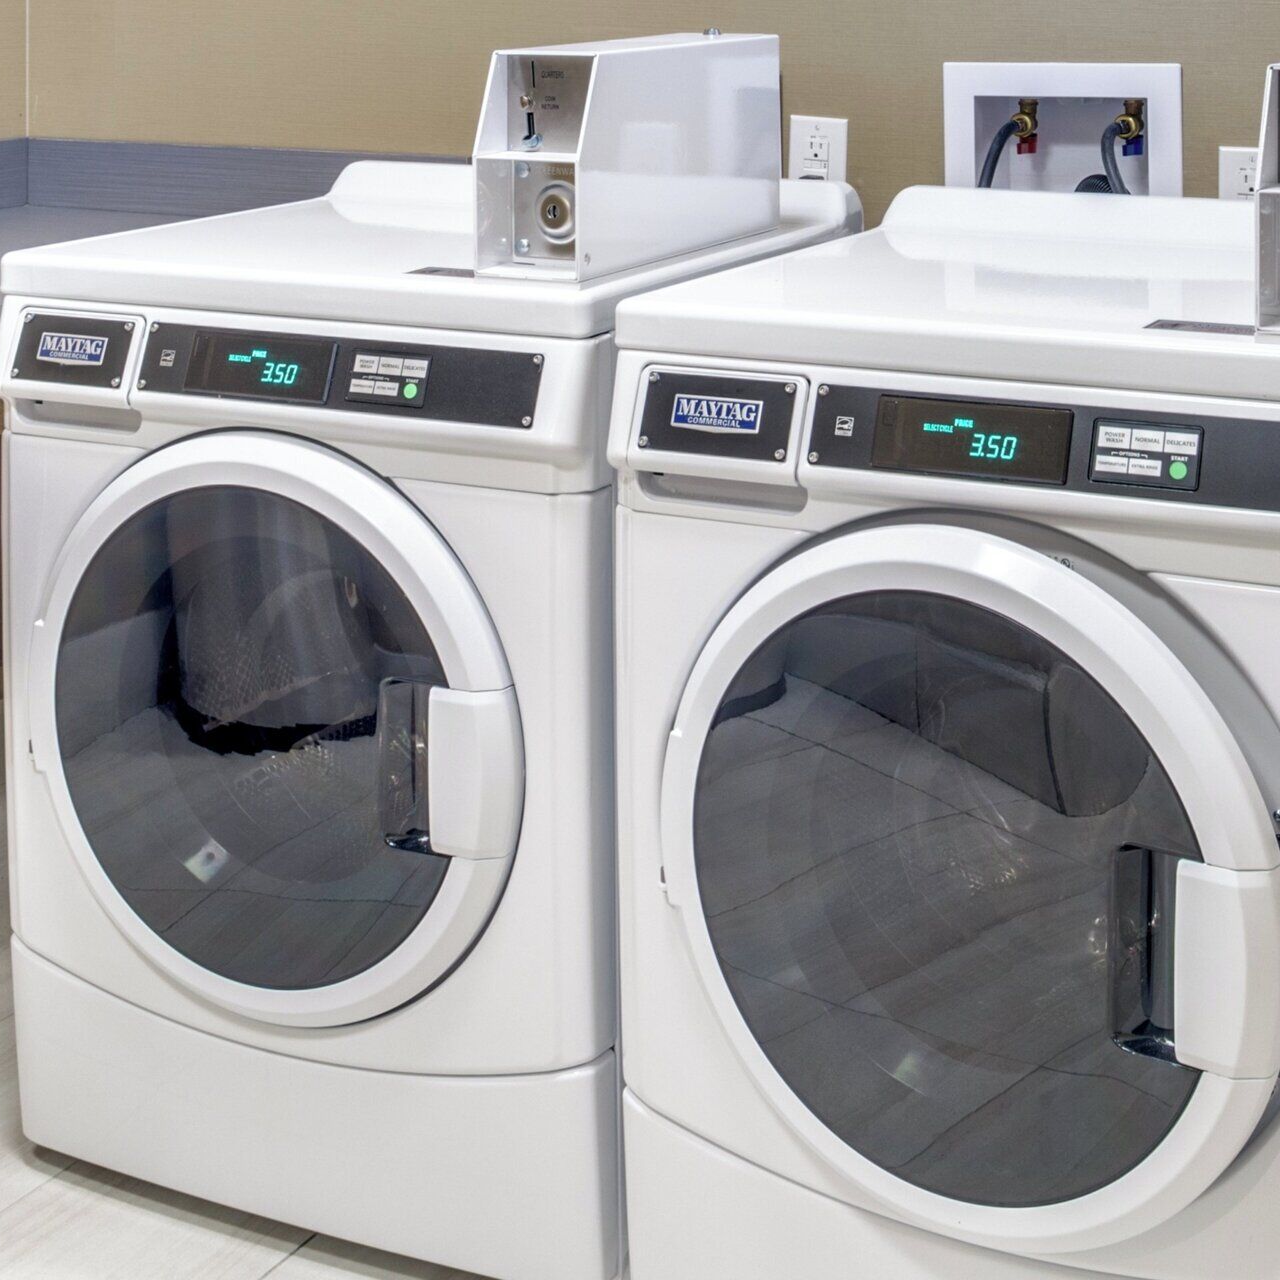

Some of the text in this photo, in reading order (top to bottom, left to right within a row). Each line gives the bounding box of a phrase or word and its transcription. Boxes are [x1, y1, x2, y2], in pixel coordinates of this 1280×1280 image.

[42, 336, 102, 355] MAYTAG
[49, 350, 88, 360] COMMERCIAL
[677, 398, 756, 422] MAYTAG
[687, 416, 741, 428] COMMERCIAL
[954, 418, 974, 428] PRICE
[969, 433, 1017, 460] 3.50
[1166, 440, 1196, 448] DELICATES
